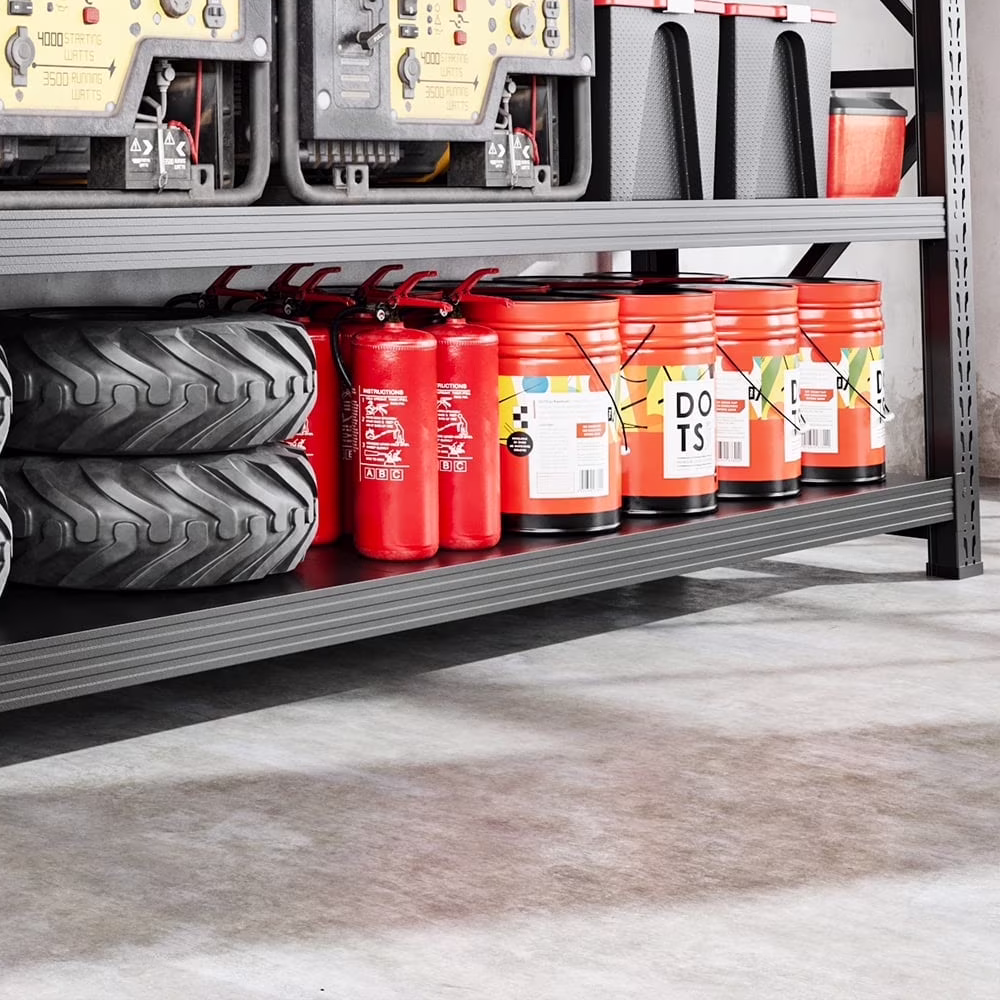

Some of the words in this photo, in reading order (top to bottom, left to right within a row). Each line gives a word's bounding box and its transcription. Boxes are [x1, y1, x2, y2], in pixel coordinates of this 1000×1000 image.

[37, 31, 63, 47] 4000
[63, 49, 95, 62] WATTS
[421, 51, 440, 65] 4000
[43, 71, 69, 87] 3500
[71, 88, 102, 101] WATTS
[676, 390, 712, 419] DO
[676, 422, 705, 452] TS
[443, 461, 450, 470] B
[456, 461, 464, 470] C
[366, 470, 374, 478] A
[392, 470, 401, 479] C
